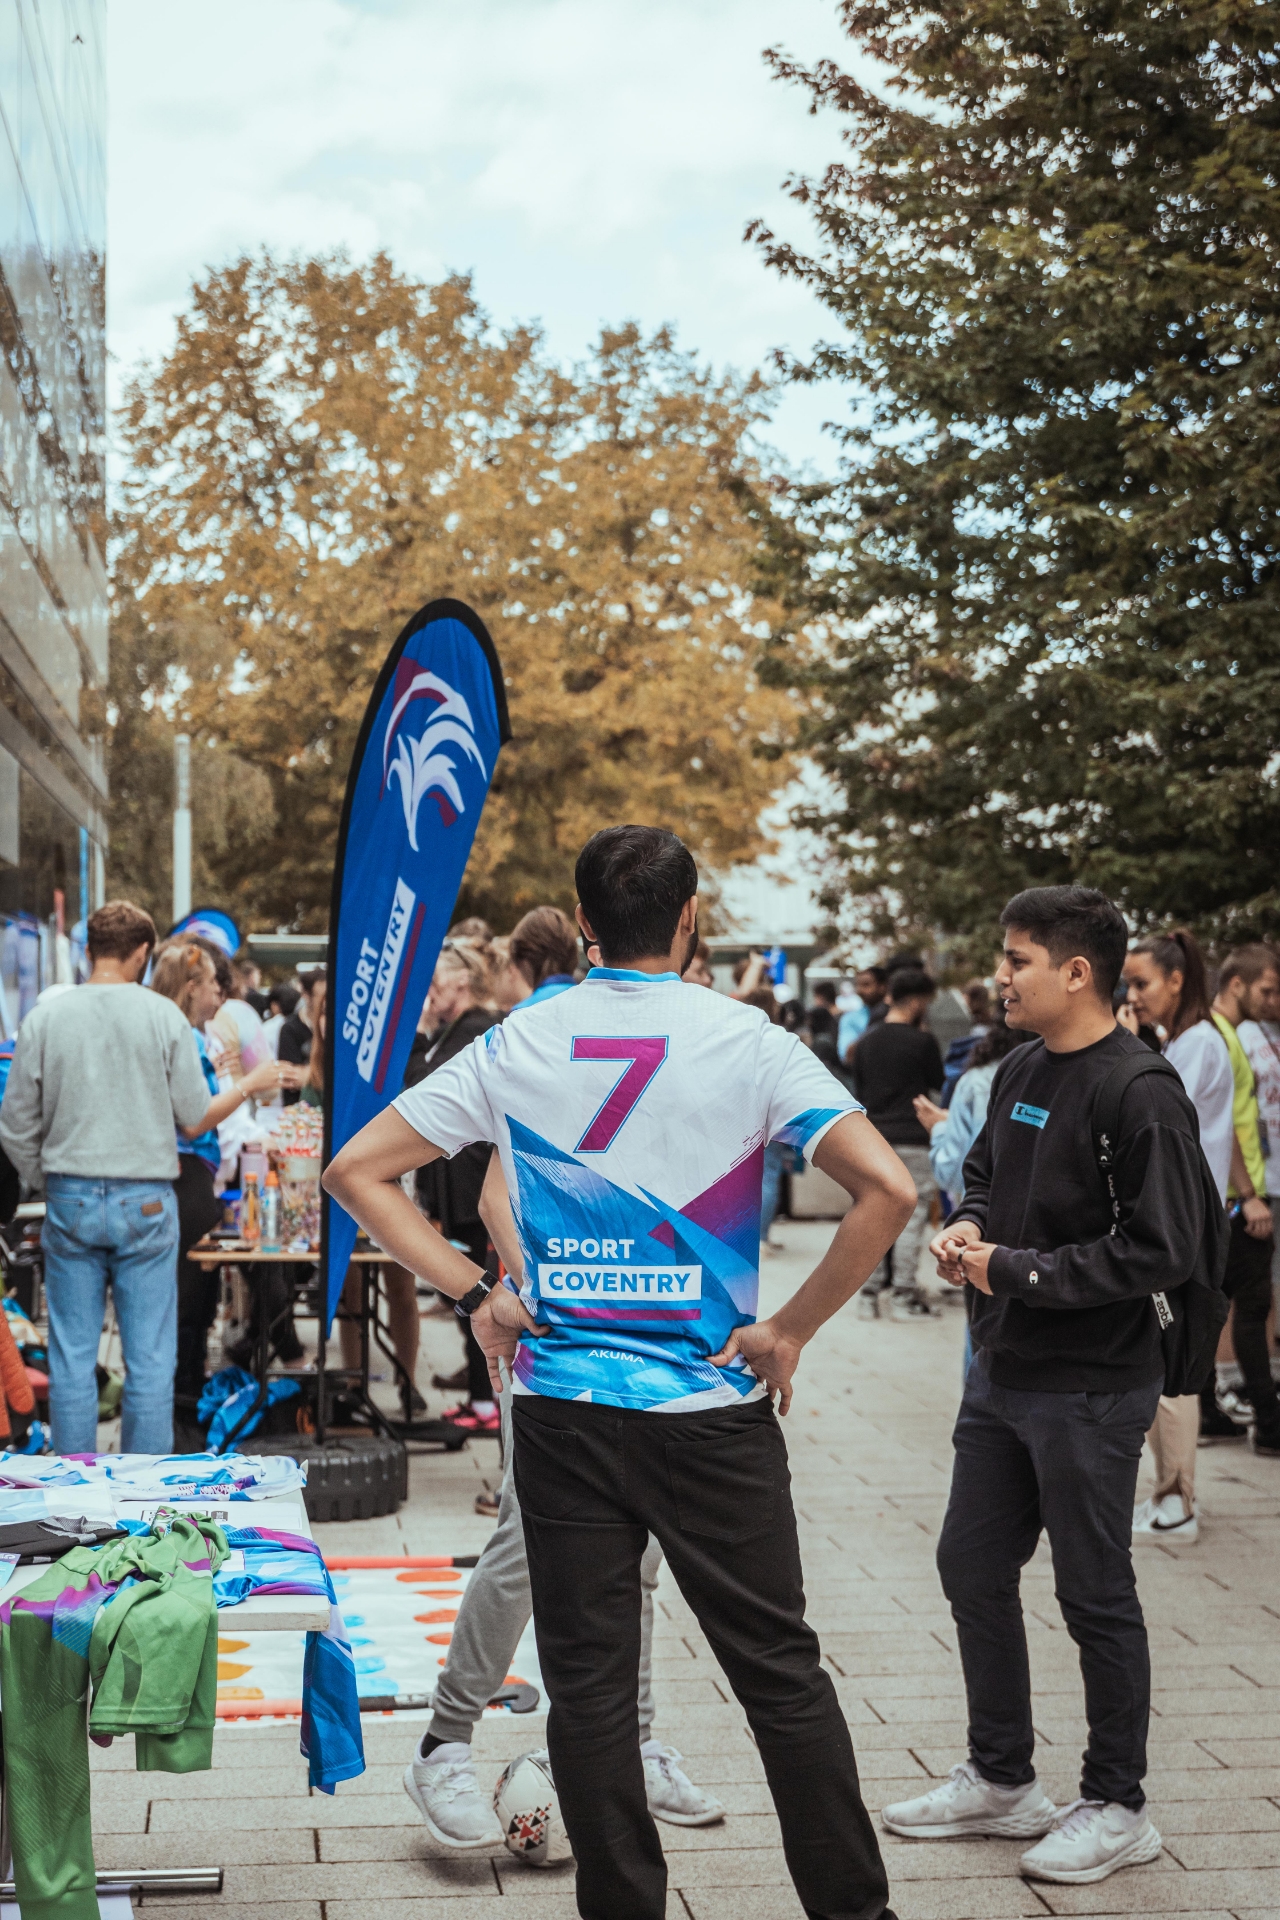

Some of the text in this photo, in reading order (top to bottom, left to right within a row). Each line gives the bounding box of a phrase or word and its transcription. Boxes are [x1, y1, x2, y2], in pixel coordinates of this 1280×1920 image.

[343, 937, 379, 1045] SPORT
[570, 1035, 669, 1153] 7
[547, 1238, 635, 1259] SPORT
[548, 1271, 691, 1293] COVENTRY
[588, 1349, 645, 1365] AKUMA
